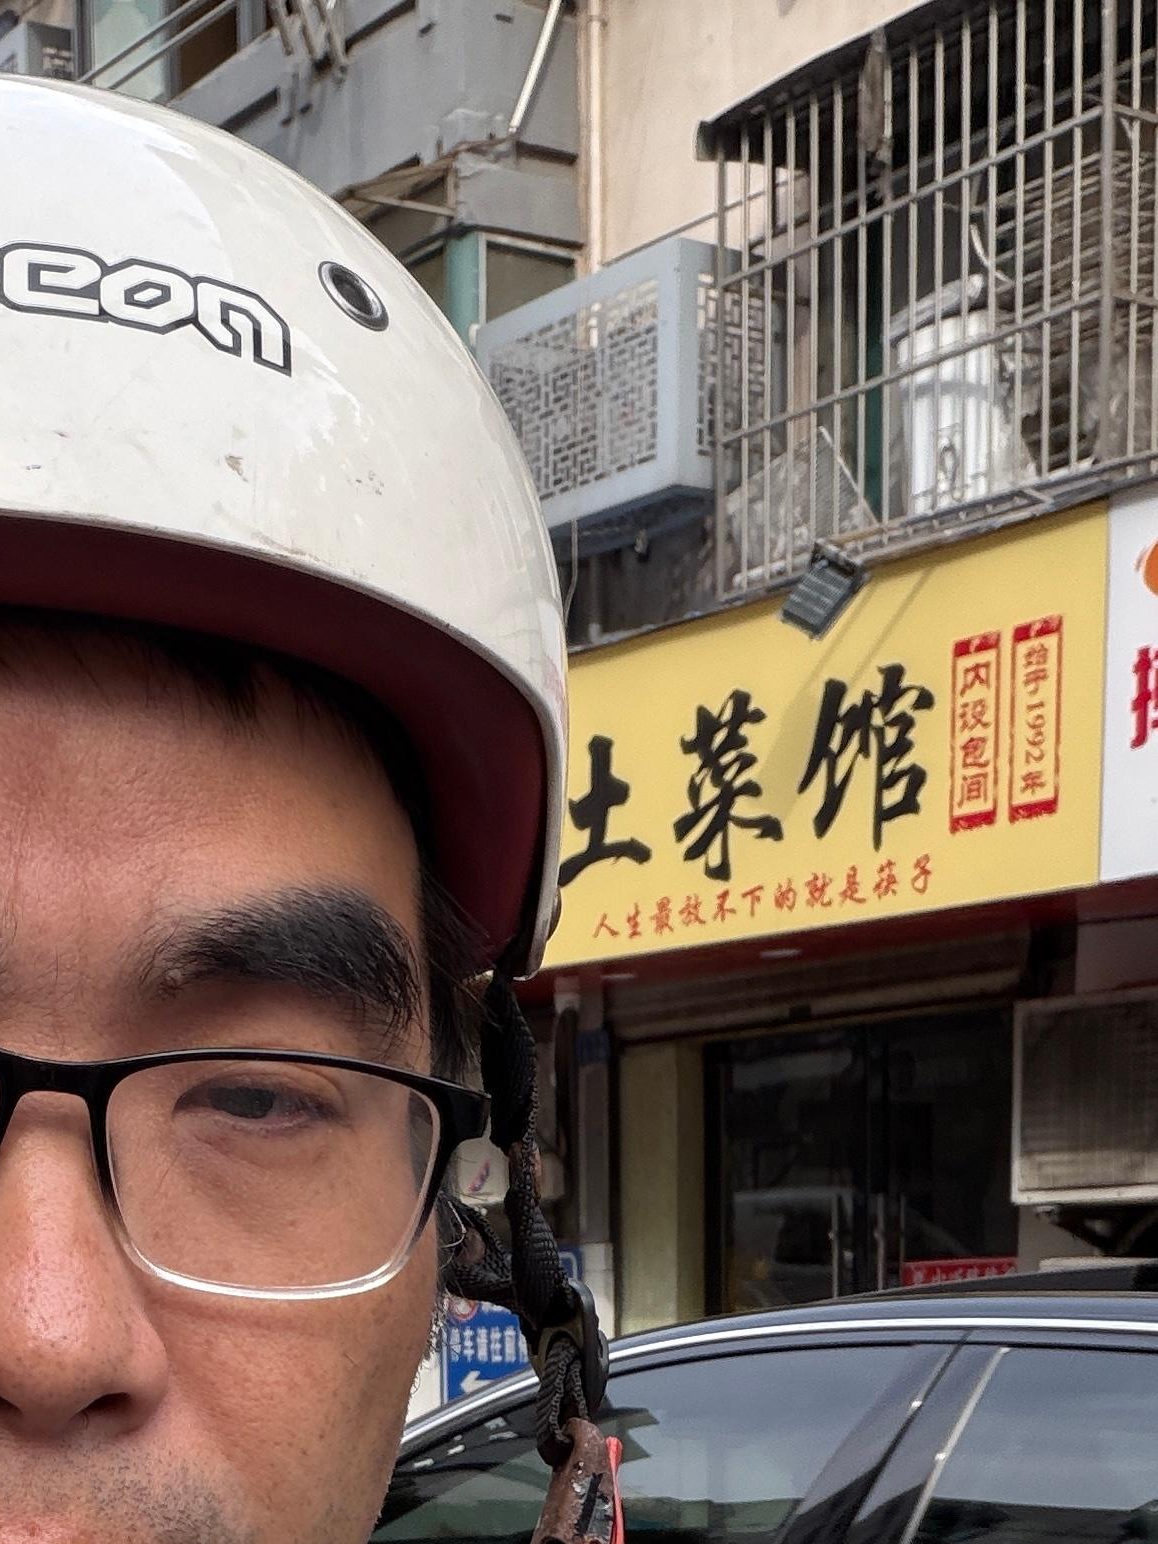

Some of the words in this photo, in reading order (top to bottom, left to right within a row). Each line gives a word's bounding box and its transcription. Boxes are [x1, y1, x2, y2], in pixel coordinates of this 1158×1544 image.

[559, 662, 935, 888] 土菜馆
[592, 853, 933, 940] 人生最放不下的就是筷子
